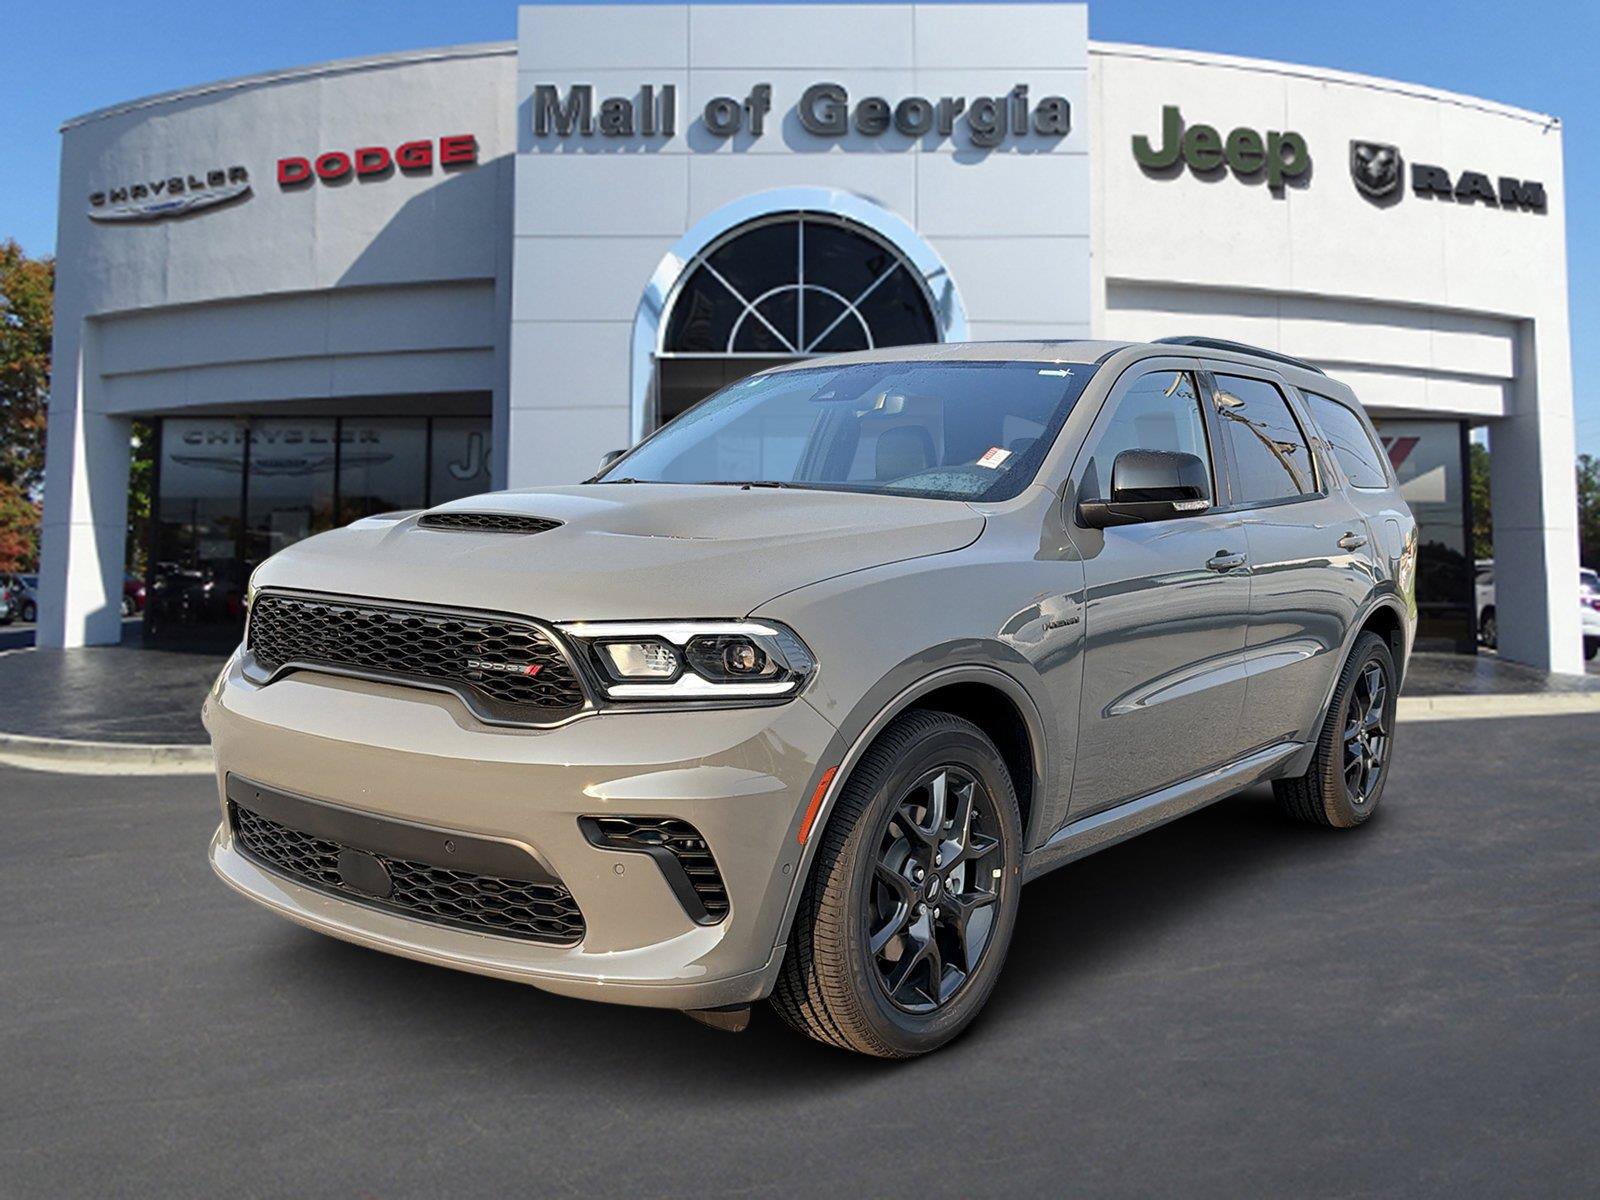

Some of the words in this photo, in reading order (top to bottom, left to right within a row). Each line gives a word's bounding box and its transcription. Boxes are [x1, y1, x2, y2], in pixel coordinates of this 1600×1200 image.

[533, 84, 678, 137] Mall
[703, 83, 772, 137] of
[799, 82, 1071, 148] Georgia
[277, 134, 477, 187] DODGE
[1131, 105, 1310, 192] Jeep
[90, 166, 250, 207] CHRYSLER
[1411, 163, 1548, 214] RAM
[467, 660, 526, 674] DODGE
